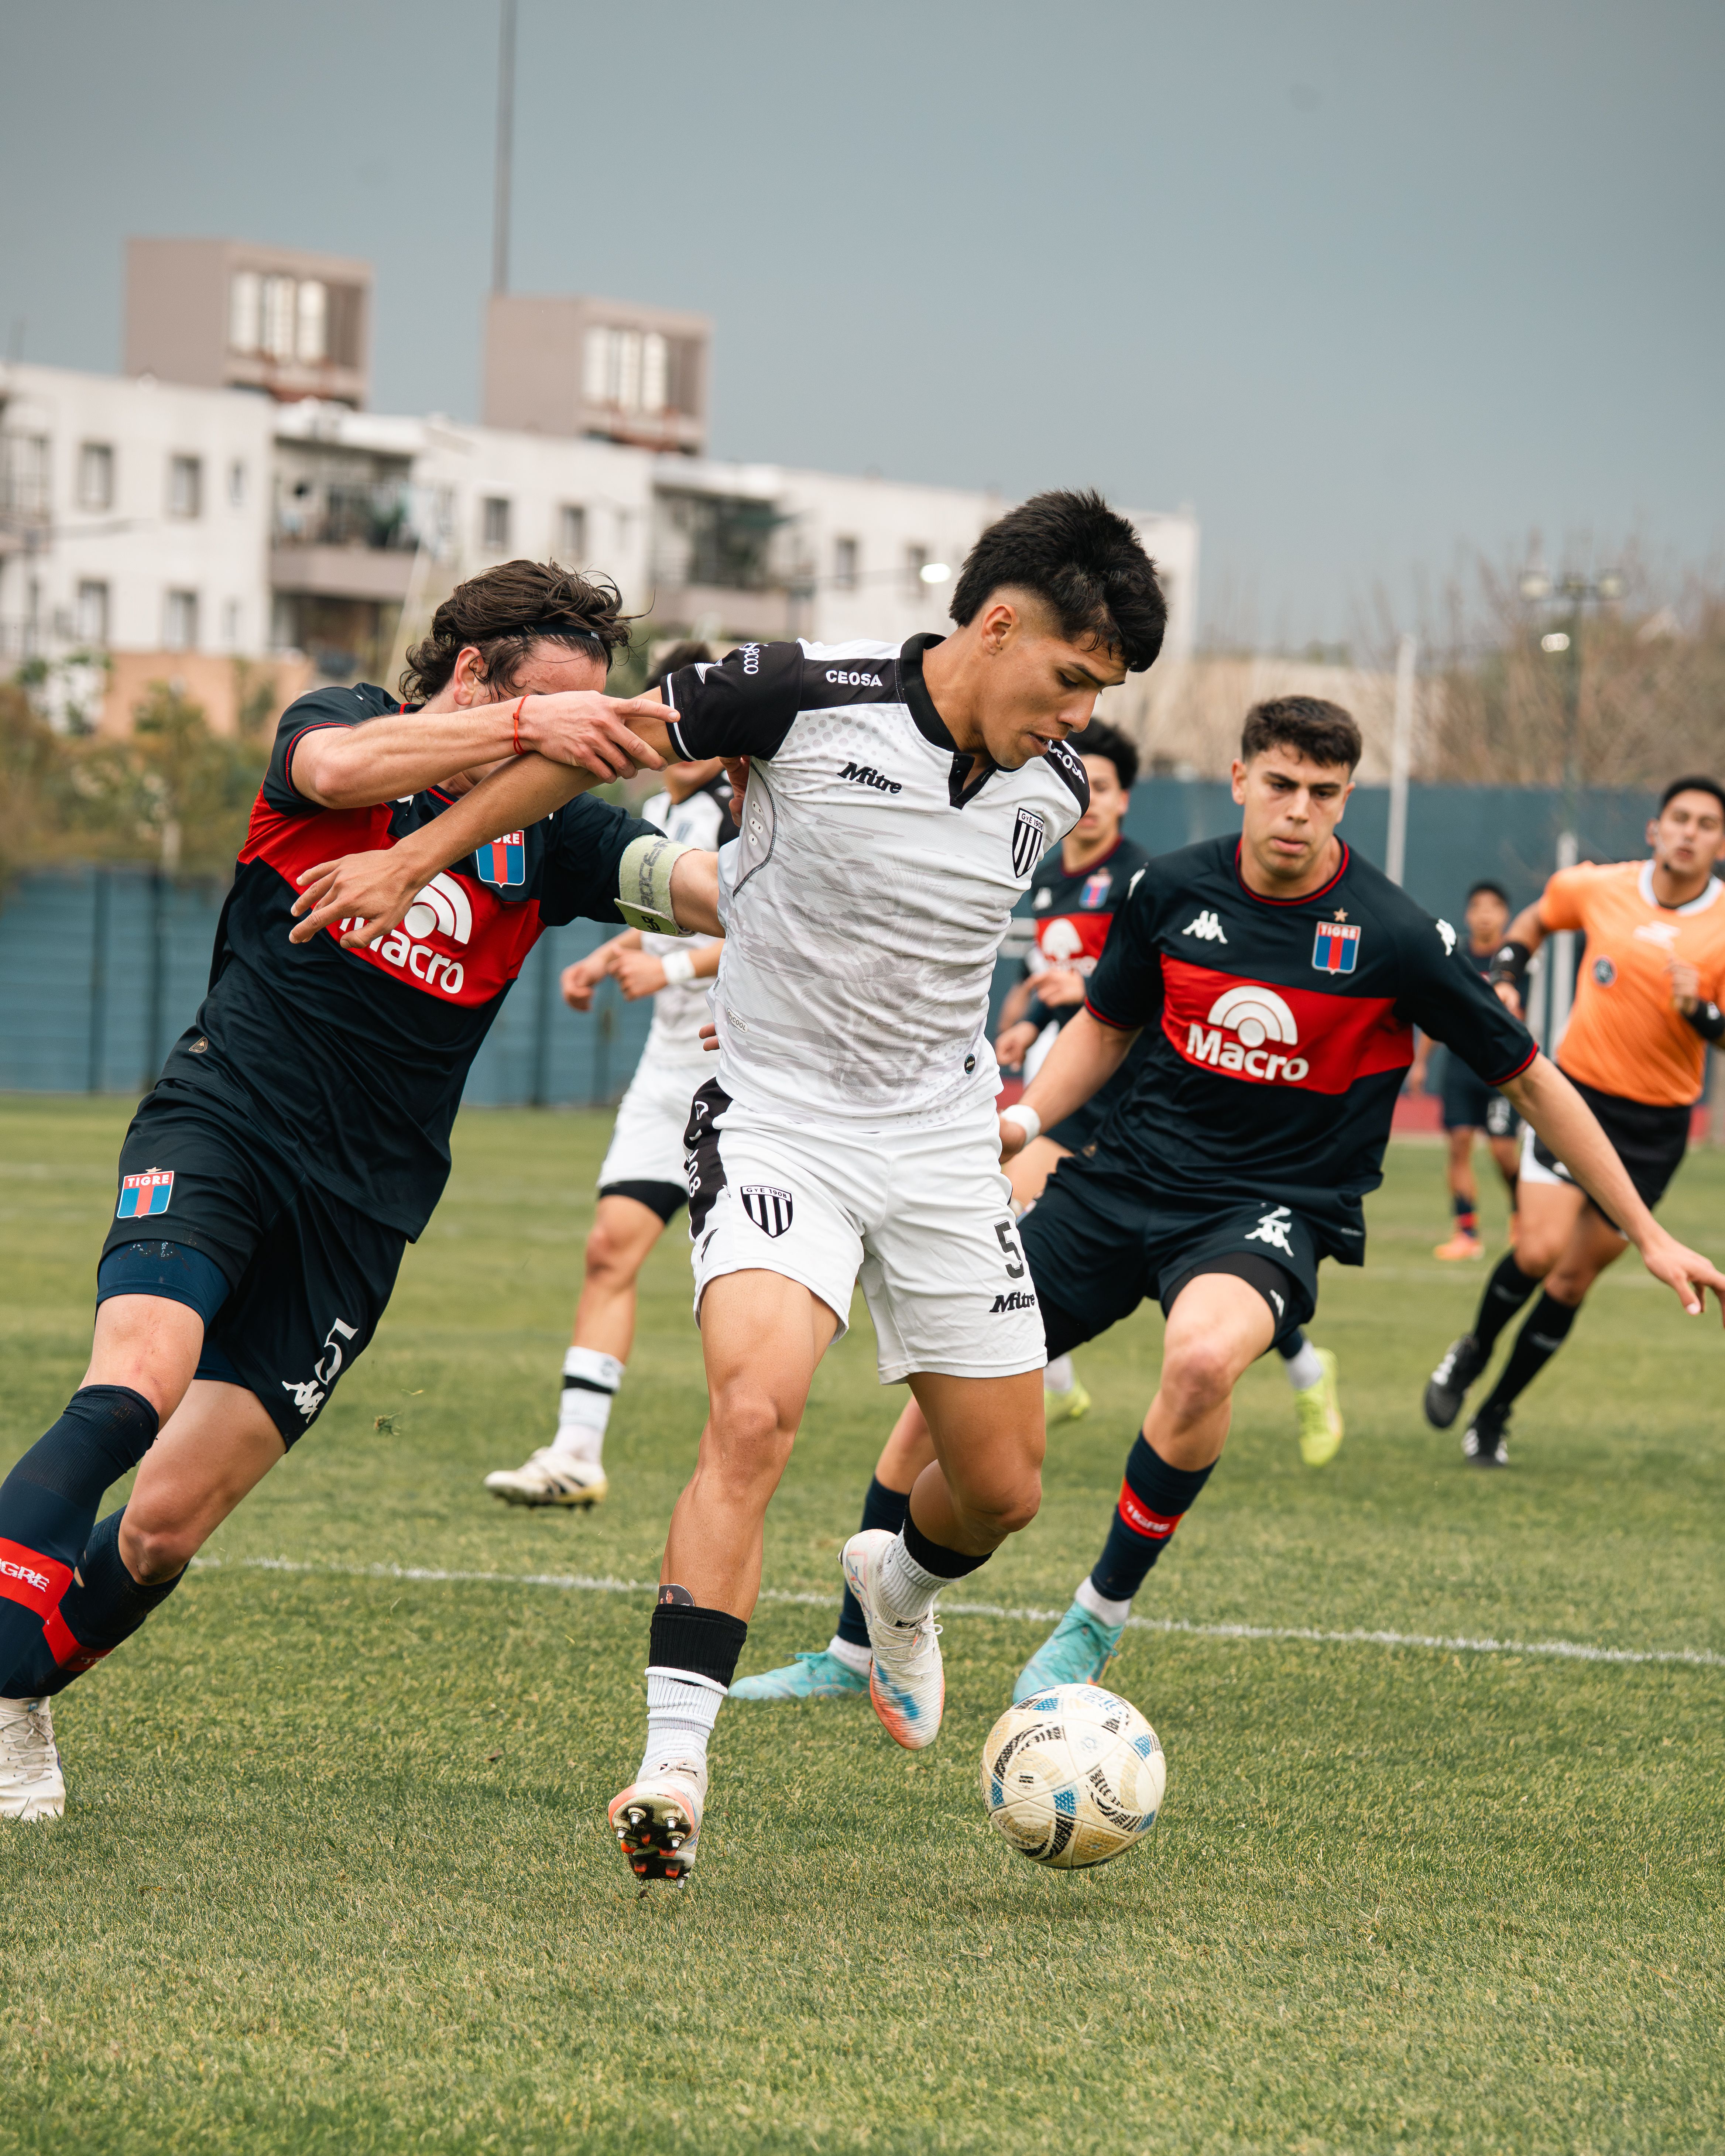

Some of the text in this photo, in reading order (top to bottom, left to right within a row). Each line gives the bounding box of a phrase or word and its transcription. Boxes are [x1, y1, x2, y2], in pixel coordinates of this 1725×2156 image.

[826, 670, 883, 687] CEOSA
[836, 762, 902, 794] Mitre
[1034, 819, 1043, 830] 1908
[1186, 1023, 1310, 1082] Macro
[128, 1174, 169, 1187] TIGRE
[769, 1189, 787, 1198] 1908
[994, 1219, 1025, 1279] 5
[989, 1292, 1035, 1313] Mitre
[314, 1317, 359, 1385] 5
